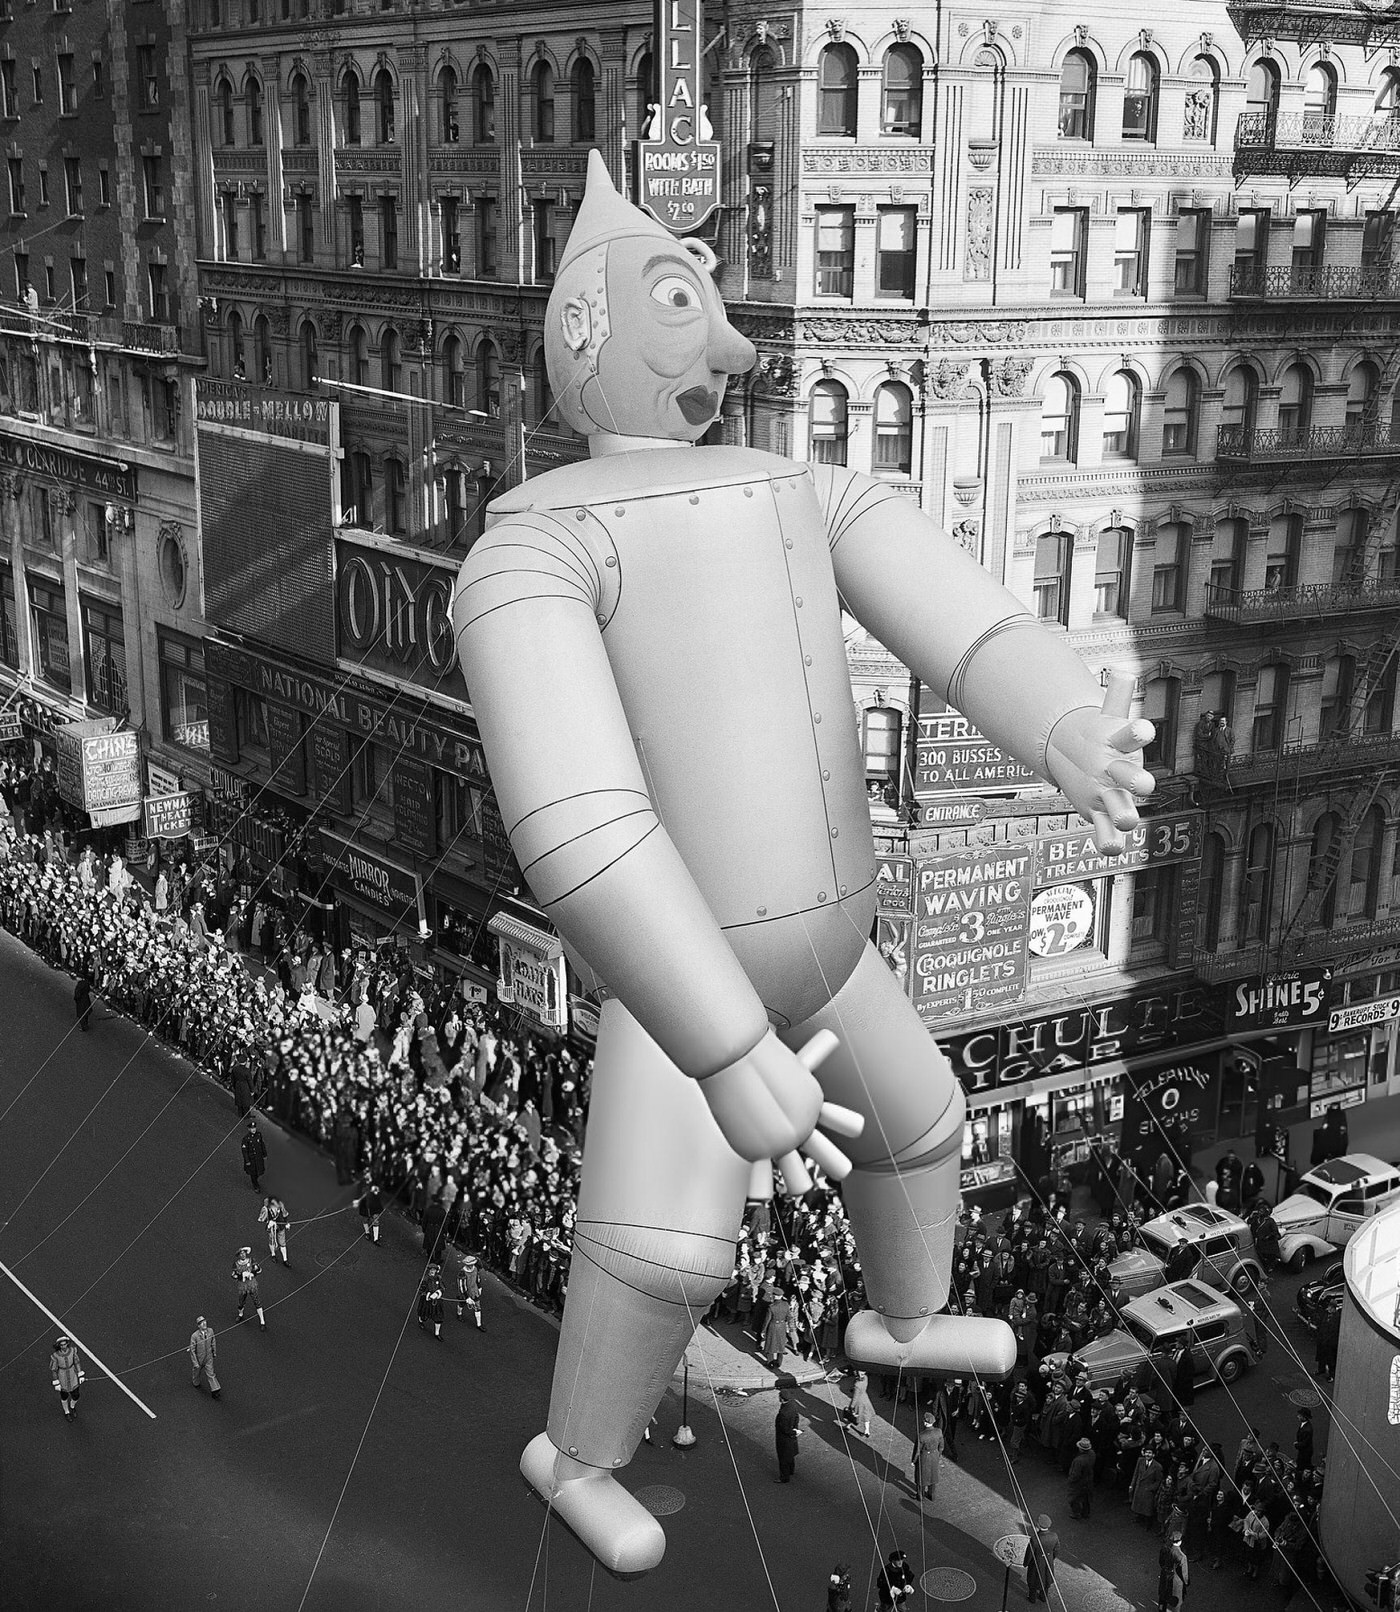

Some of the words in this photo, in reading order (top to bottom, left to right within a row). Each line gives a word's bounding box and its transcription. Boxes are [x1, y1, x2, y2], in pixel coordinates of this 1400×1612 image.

[645, 152, 689, 172] ROOMS
[648, 177, 680, 196] WITH
[682, 177, 713, 196] BATH
[26, 447, 87, 482] CLARIDGE
[260, 664, 351, 723] NATIONAL
[358, 702, 448, 760] BEAUTY
[919, 750, 947, 767] 300
[952, 747, 1002, 765] BUSSES
[921, 769, 940, 783] TO
[943, 768, 971, 782] ALL
[925, 803, 981, 822] ENTRANCE
[1049, 828, 1148, 862] BEATY
[349, 853, 393, 902] MIRROR
[921, 856, 1029, 892] PERMANENT
[1044, 848, 1150, 879] TREATMENTS
[353, 880, 390, 907] CANDIES
[924, 881, 1022, 916] WAVING
[1031, 899, 1084, 916] PERMANENT
[1045, 910, 1071, 922] WAVE
[918, 936, 957, 949] GUARANTEED
[1003, 924, 1024, 934] YEAR
[916, 940, 1023, 977] CROQUIGNOLE
[922, 959, 1016, 995] RINGLETS
[916, 1003, 927, 1013] By
[926, 996, 957, 1009] EXPERTS
[986, 983, 1020, 997] COMPLETE
[1235, 980, 1302, 1017] SHINE
[938, 988, 1203, 1069] CHULTE
[1343, 1009, 1386, 1027] RECORDS
